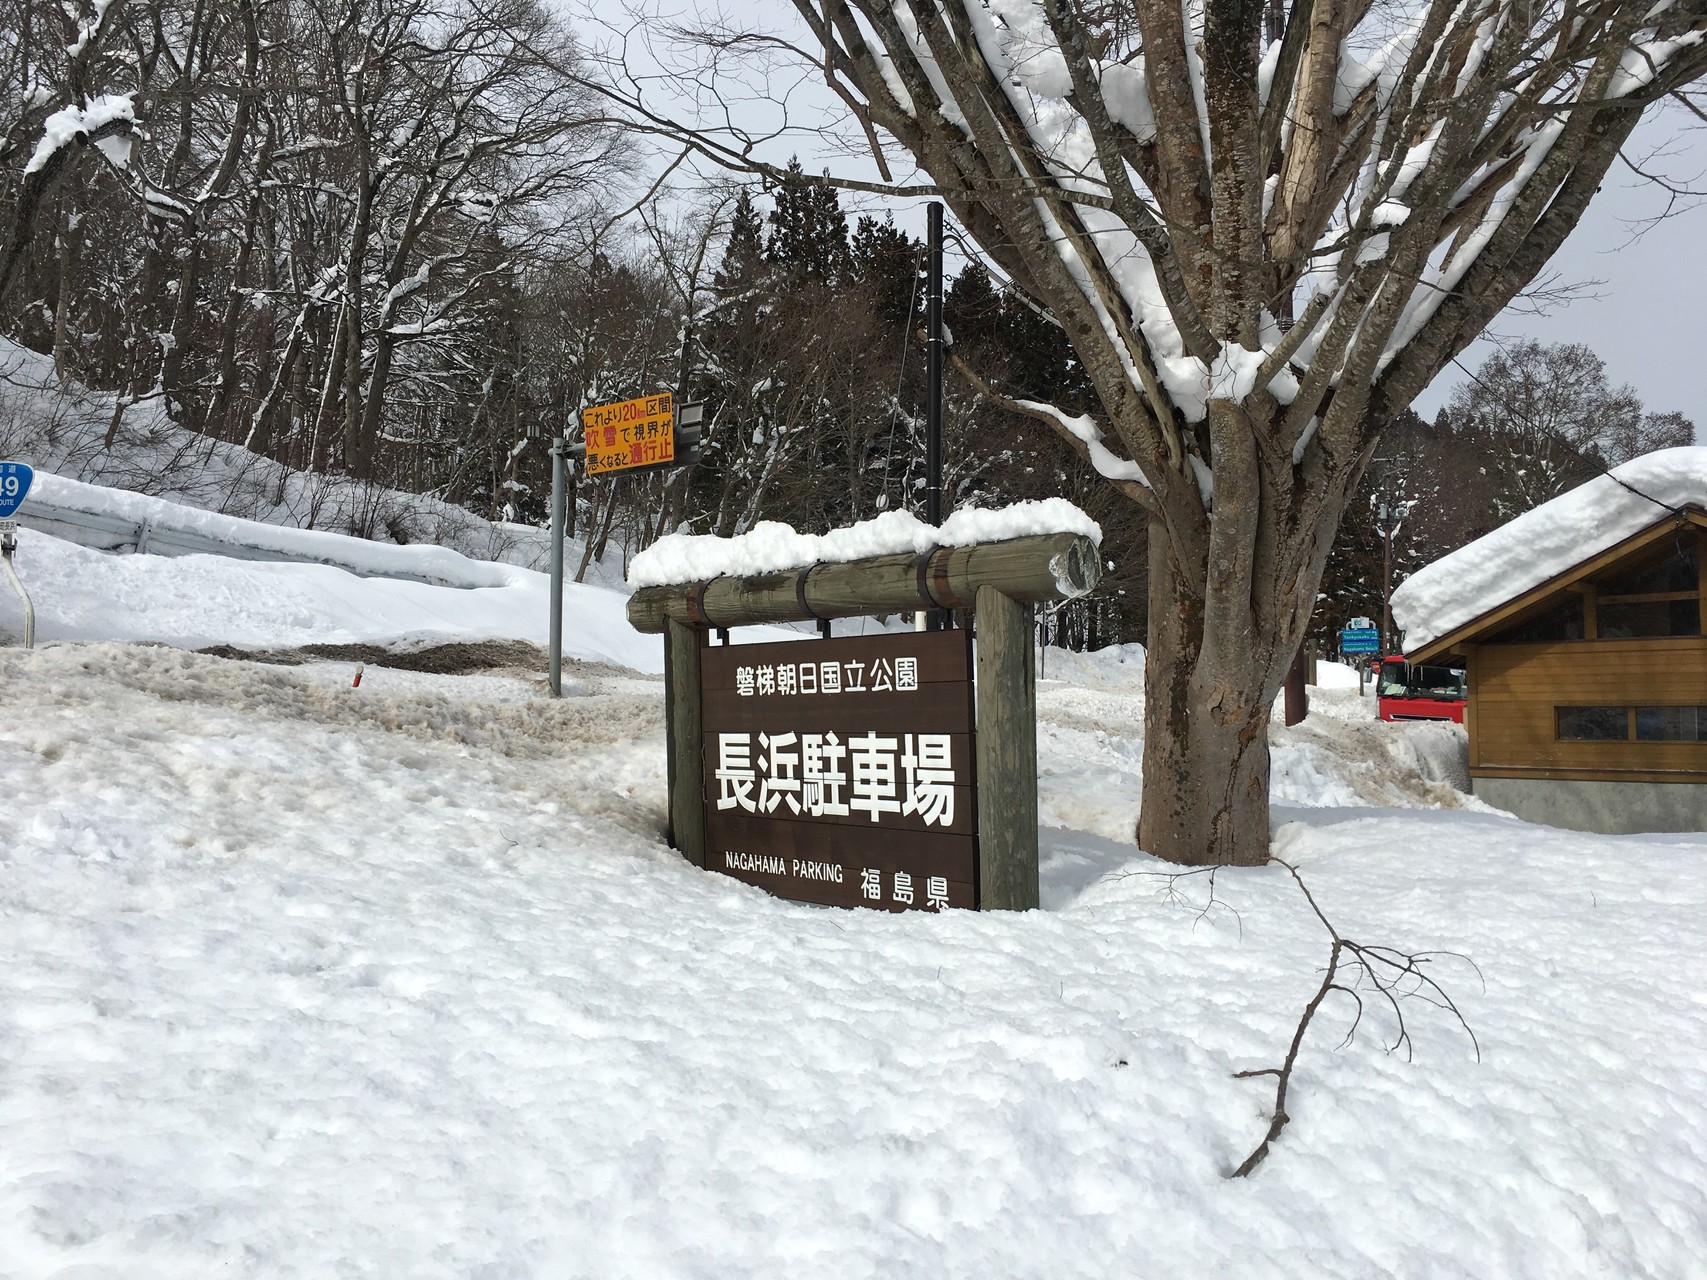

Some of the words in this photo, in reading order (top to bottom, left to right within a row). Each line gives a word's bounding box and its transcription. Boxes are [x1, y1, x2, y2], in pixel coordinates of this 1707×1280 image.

[585, 419, 671, 449] 吹雪で視界が
[588, 438, 672, 471] 悪くなると通行止
[736, 657, 918, 696] 磐梯朝日国立公園
[715, 730, 955, 827] 長浜駐車場
[725, 851, 786, 876] NAGAHAMA
[792, 859, 843, 883] PARKING
[860, 867, 949, 909] 福島県
